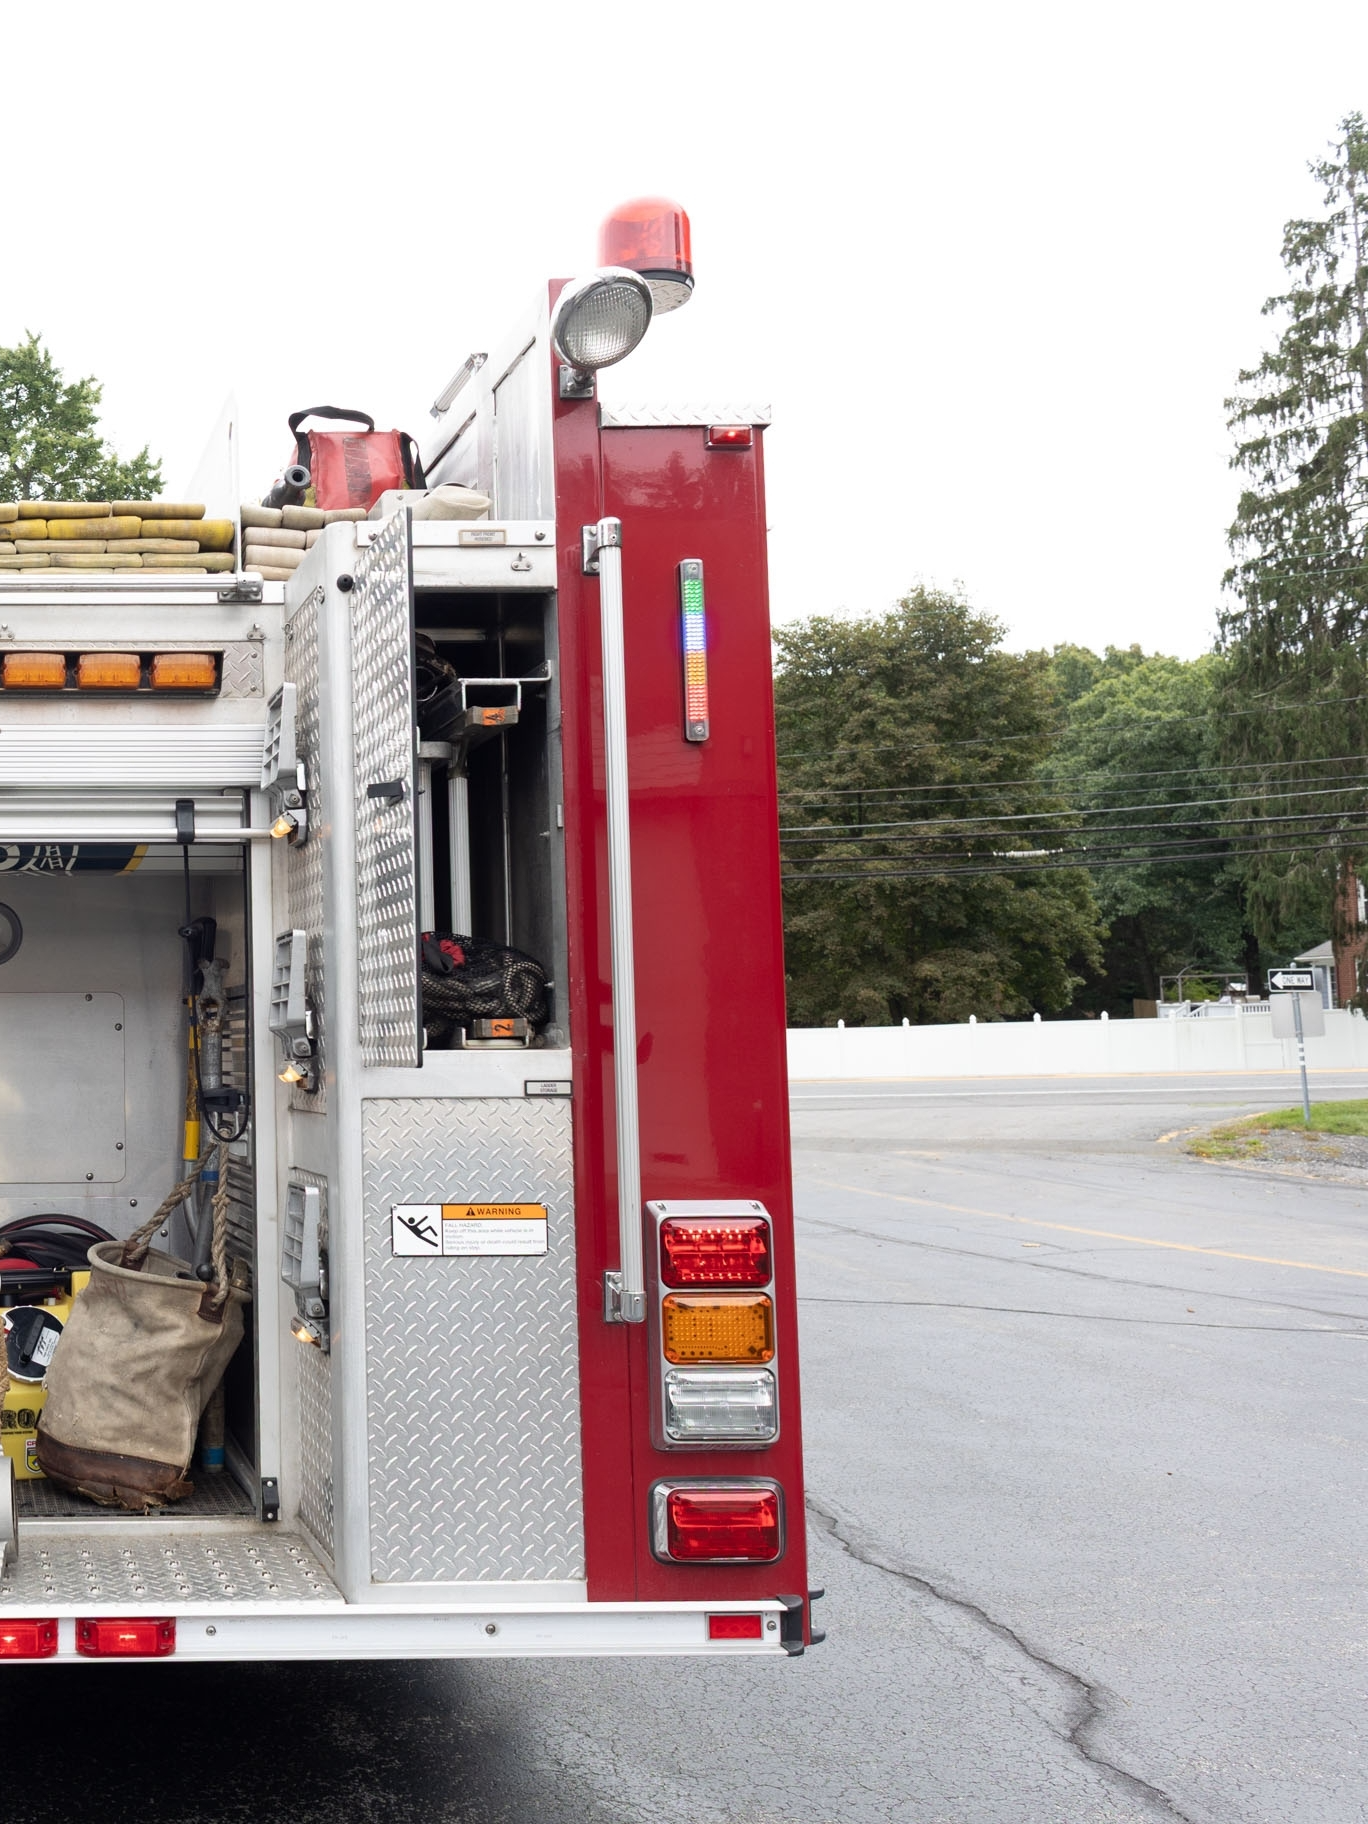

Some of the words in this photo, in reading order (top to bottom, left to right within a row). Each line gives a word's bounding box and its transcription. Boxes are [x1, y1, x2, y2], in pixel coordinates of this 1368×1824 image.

[1283, 976, 1295, 984] ONE
[1297, 976, 1309, 984] WAY
[477, 1208, 521, 1216] WARNING
